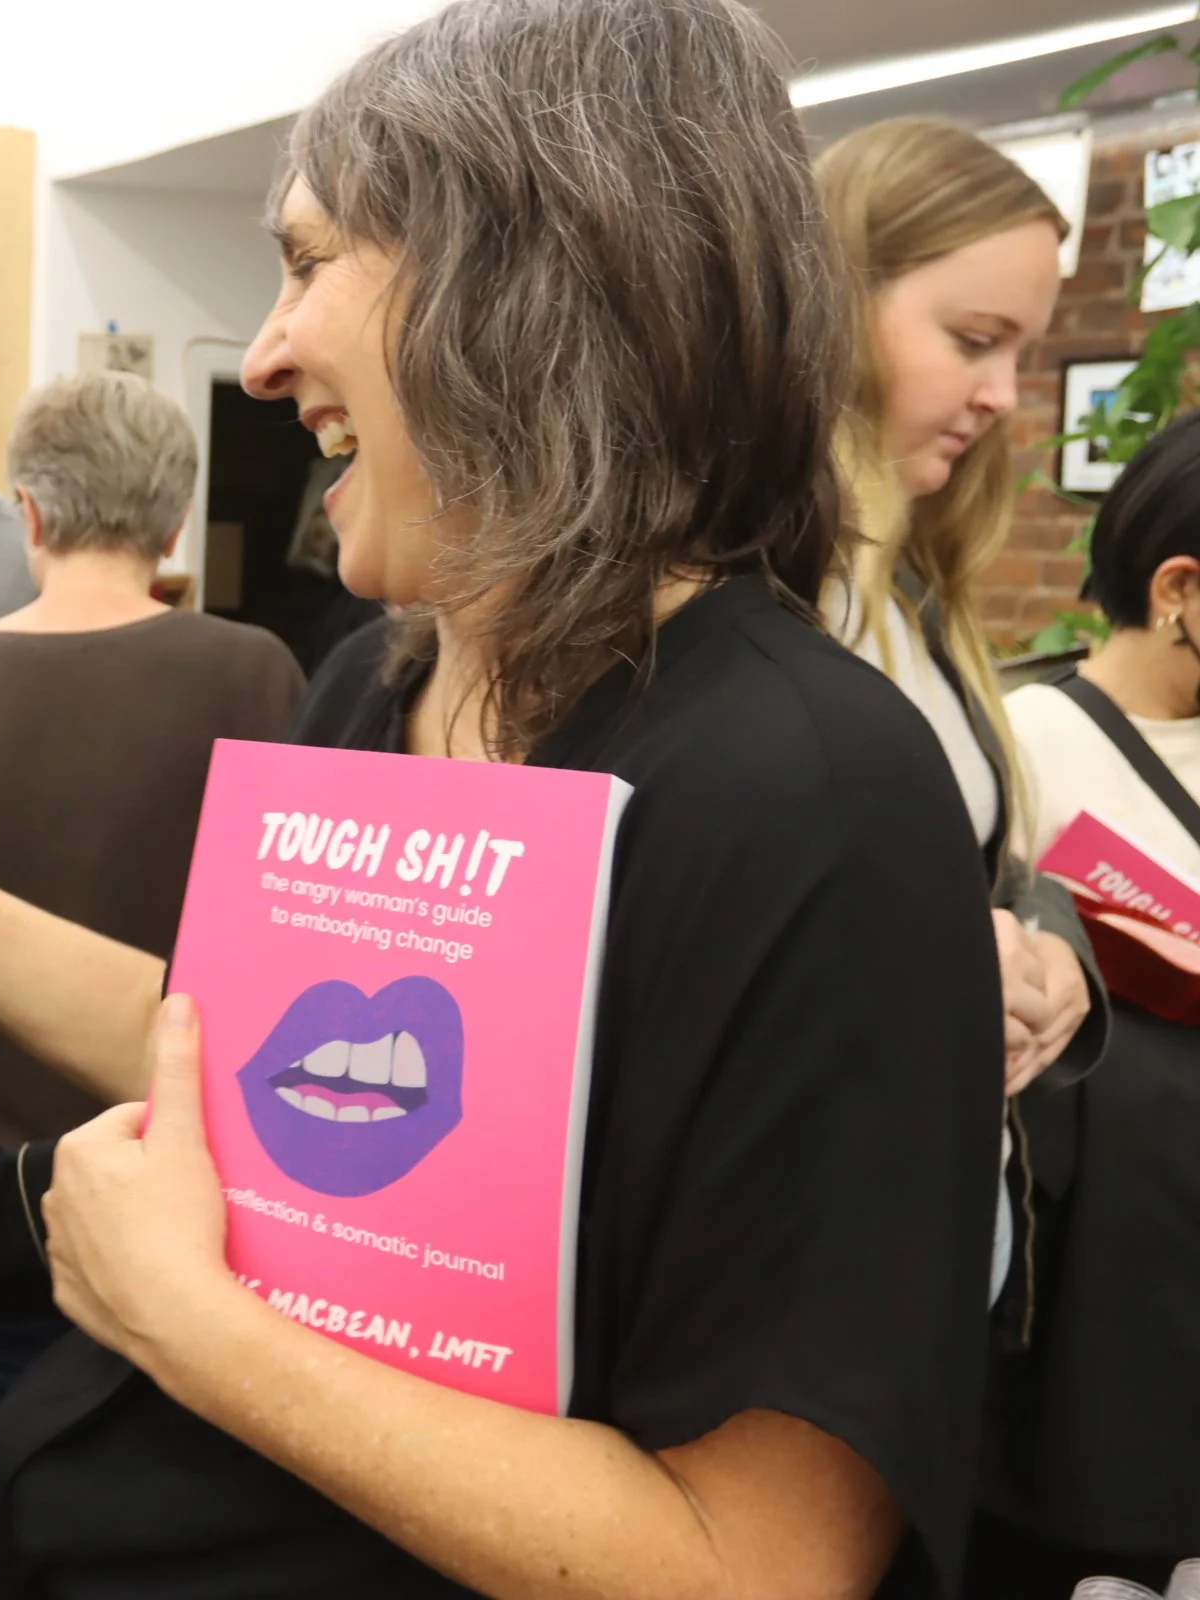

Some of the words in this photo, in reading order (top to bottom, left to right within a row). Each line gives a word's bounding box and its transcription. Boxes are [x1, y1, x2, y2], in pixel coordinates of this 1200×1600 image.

[256, 811, 391, 878] TOUGH
[396, 829, 525, 897] SH!T
[261, 872, 289, 892] the
[291, 880, 342, 907] angry
[344, 888, 429, 917] woman's
[432, 903, 493, 928] guide
[270, 905, 288, 924] to
[291, 911, 392, 951] embodying
[396, 929, 473, 963] change
[312, 1213, 327, 1233] &
[332, 1222, 419, 1259] somatic
[422, 1243, 505, 1281] journal
[428, 1331, 514, 1373] LMFT
